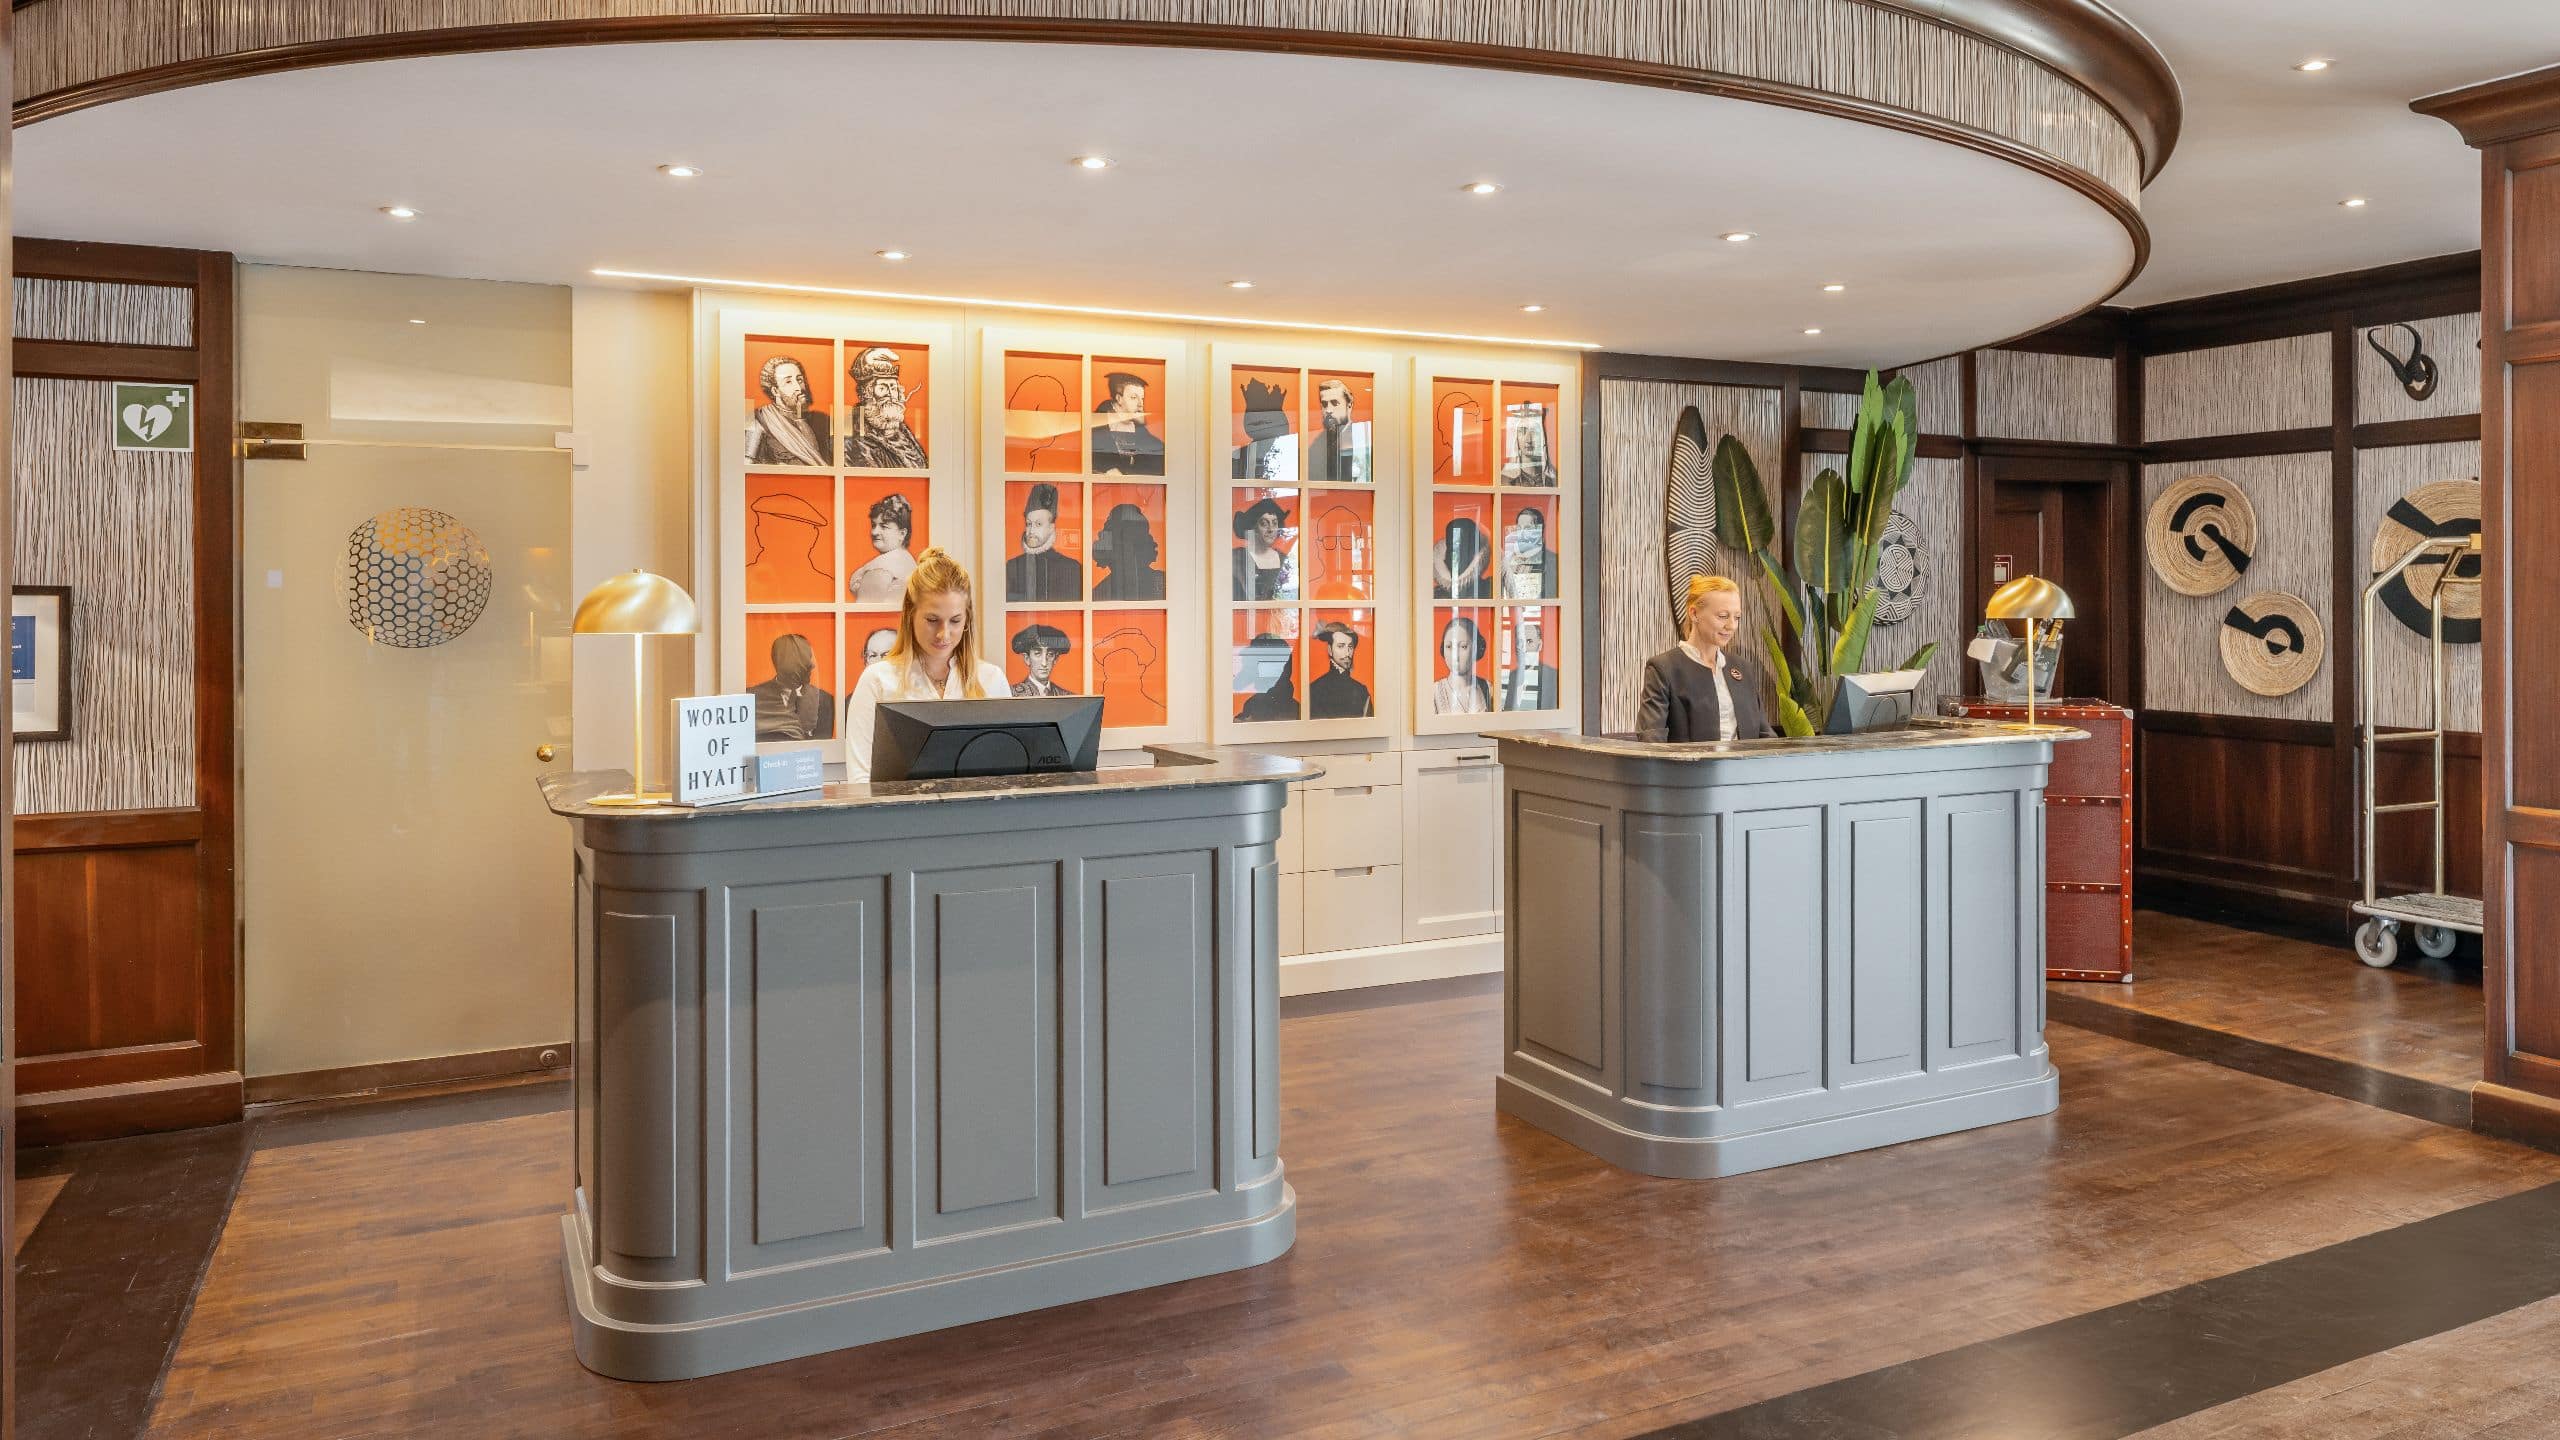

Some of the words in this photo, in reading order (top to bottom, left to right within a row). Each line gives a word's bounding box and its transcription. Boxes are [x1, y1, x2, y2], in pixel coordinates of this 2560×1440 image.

[687, 705, 749, 727] WORLD
[707, 737, 730, 757] OF
[688, 765, 748, 790] HYATT
